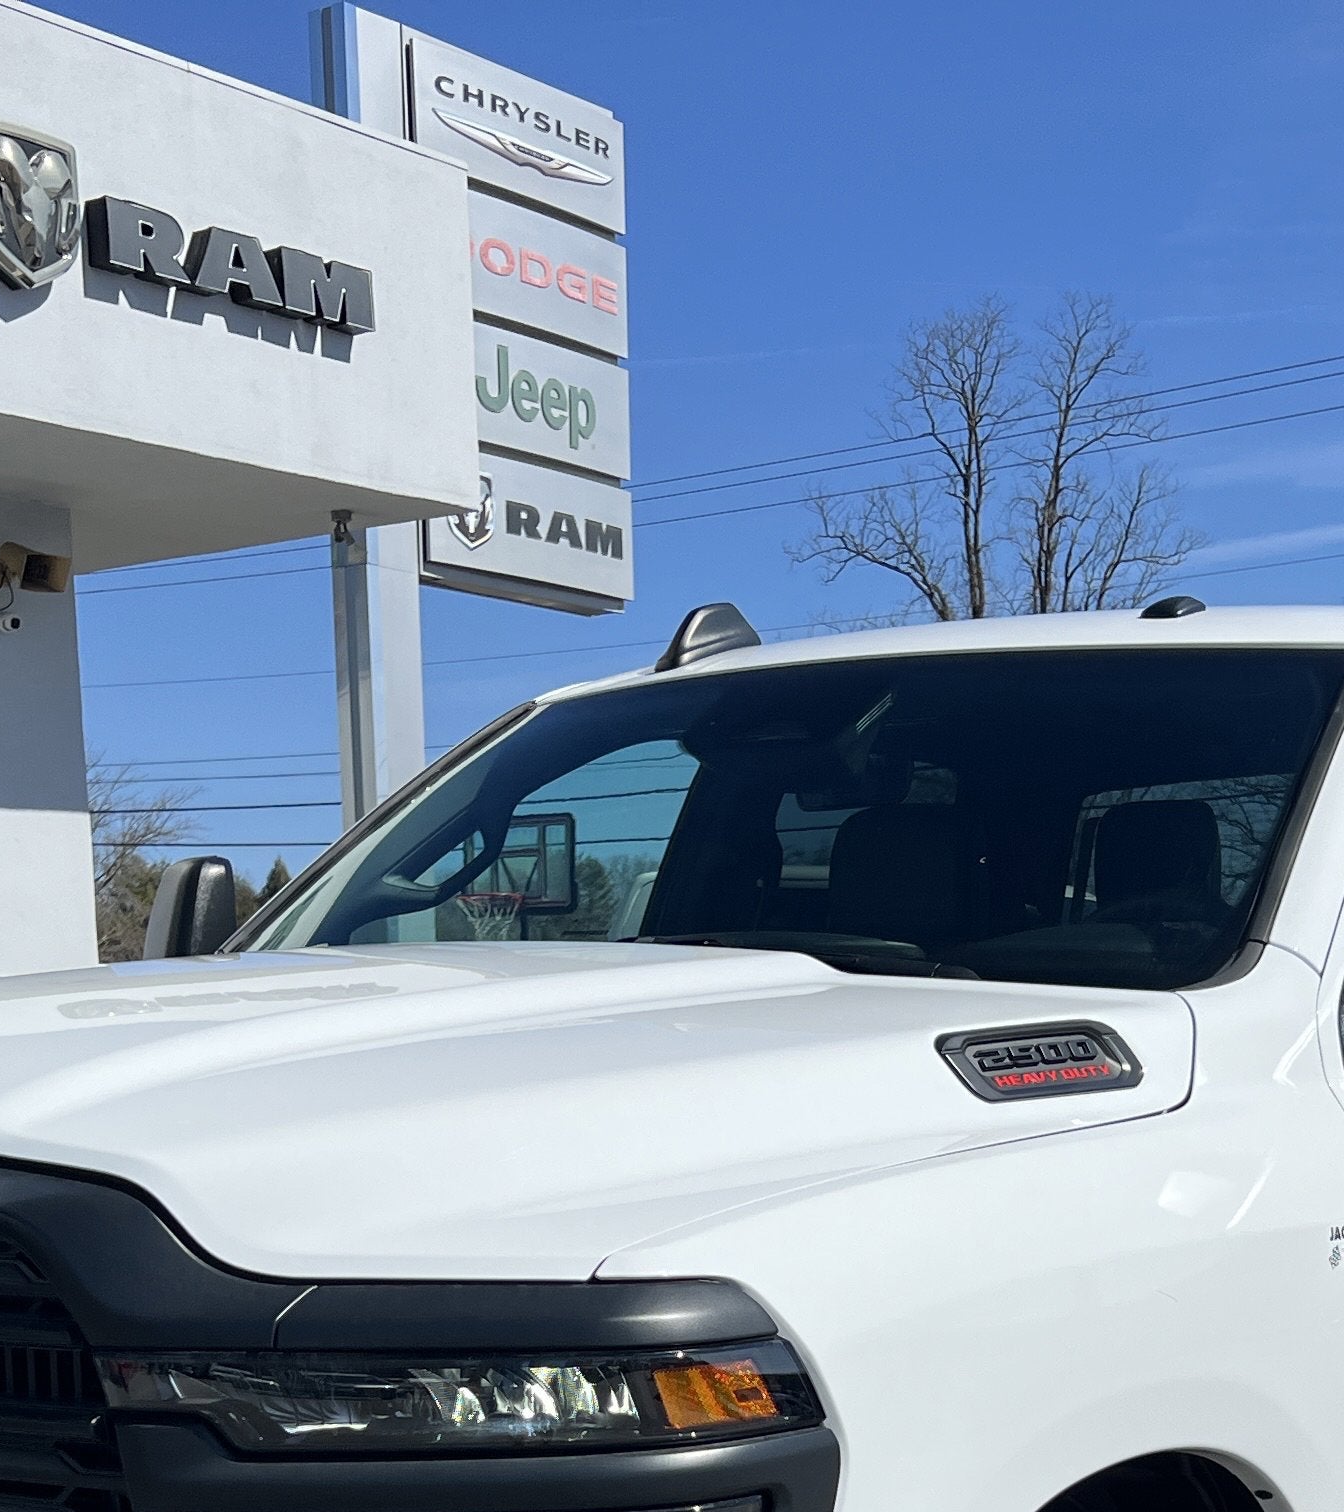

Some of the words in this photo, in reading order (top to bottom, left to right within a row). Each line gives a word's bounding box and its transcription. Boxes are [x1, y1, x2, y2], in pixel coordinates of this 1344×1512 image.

[434, 75, 610, 159] CHRYSLER
[84, 196, 375, 336] RAM
[470, 237, 618, 316] ODGE
[475, 344, 597, 449] Jeep
[505, 500, 623, 560] RAM
[972, 1040, 1098, 1072] 2500
[994, 1070, 1057, 1087] HEAVY
[1060, 1064, 1109, 1080] DUTY
